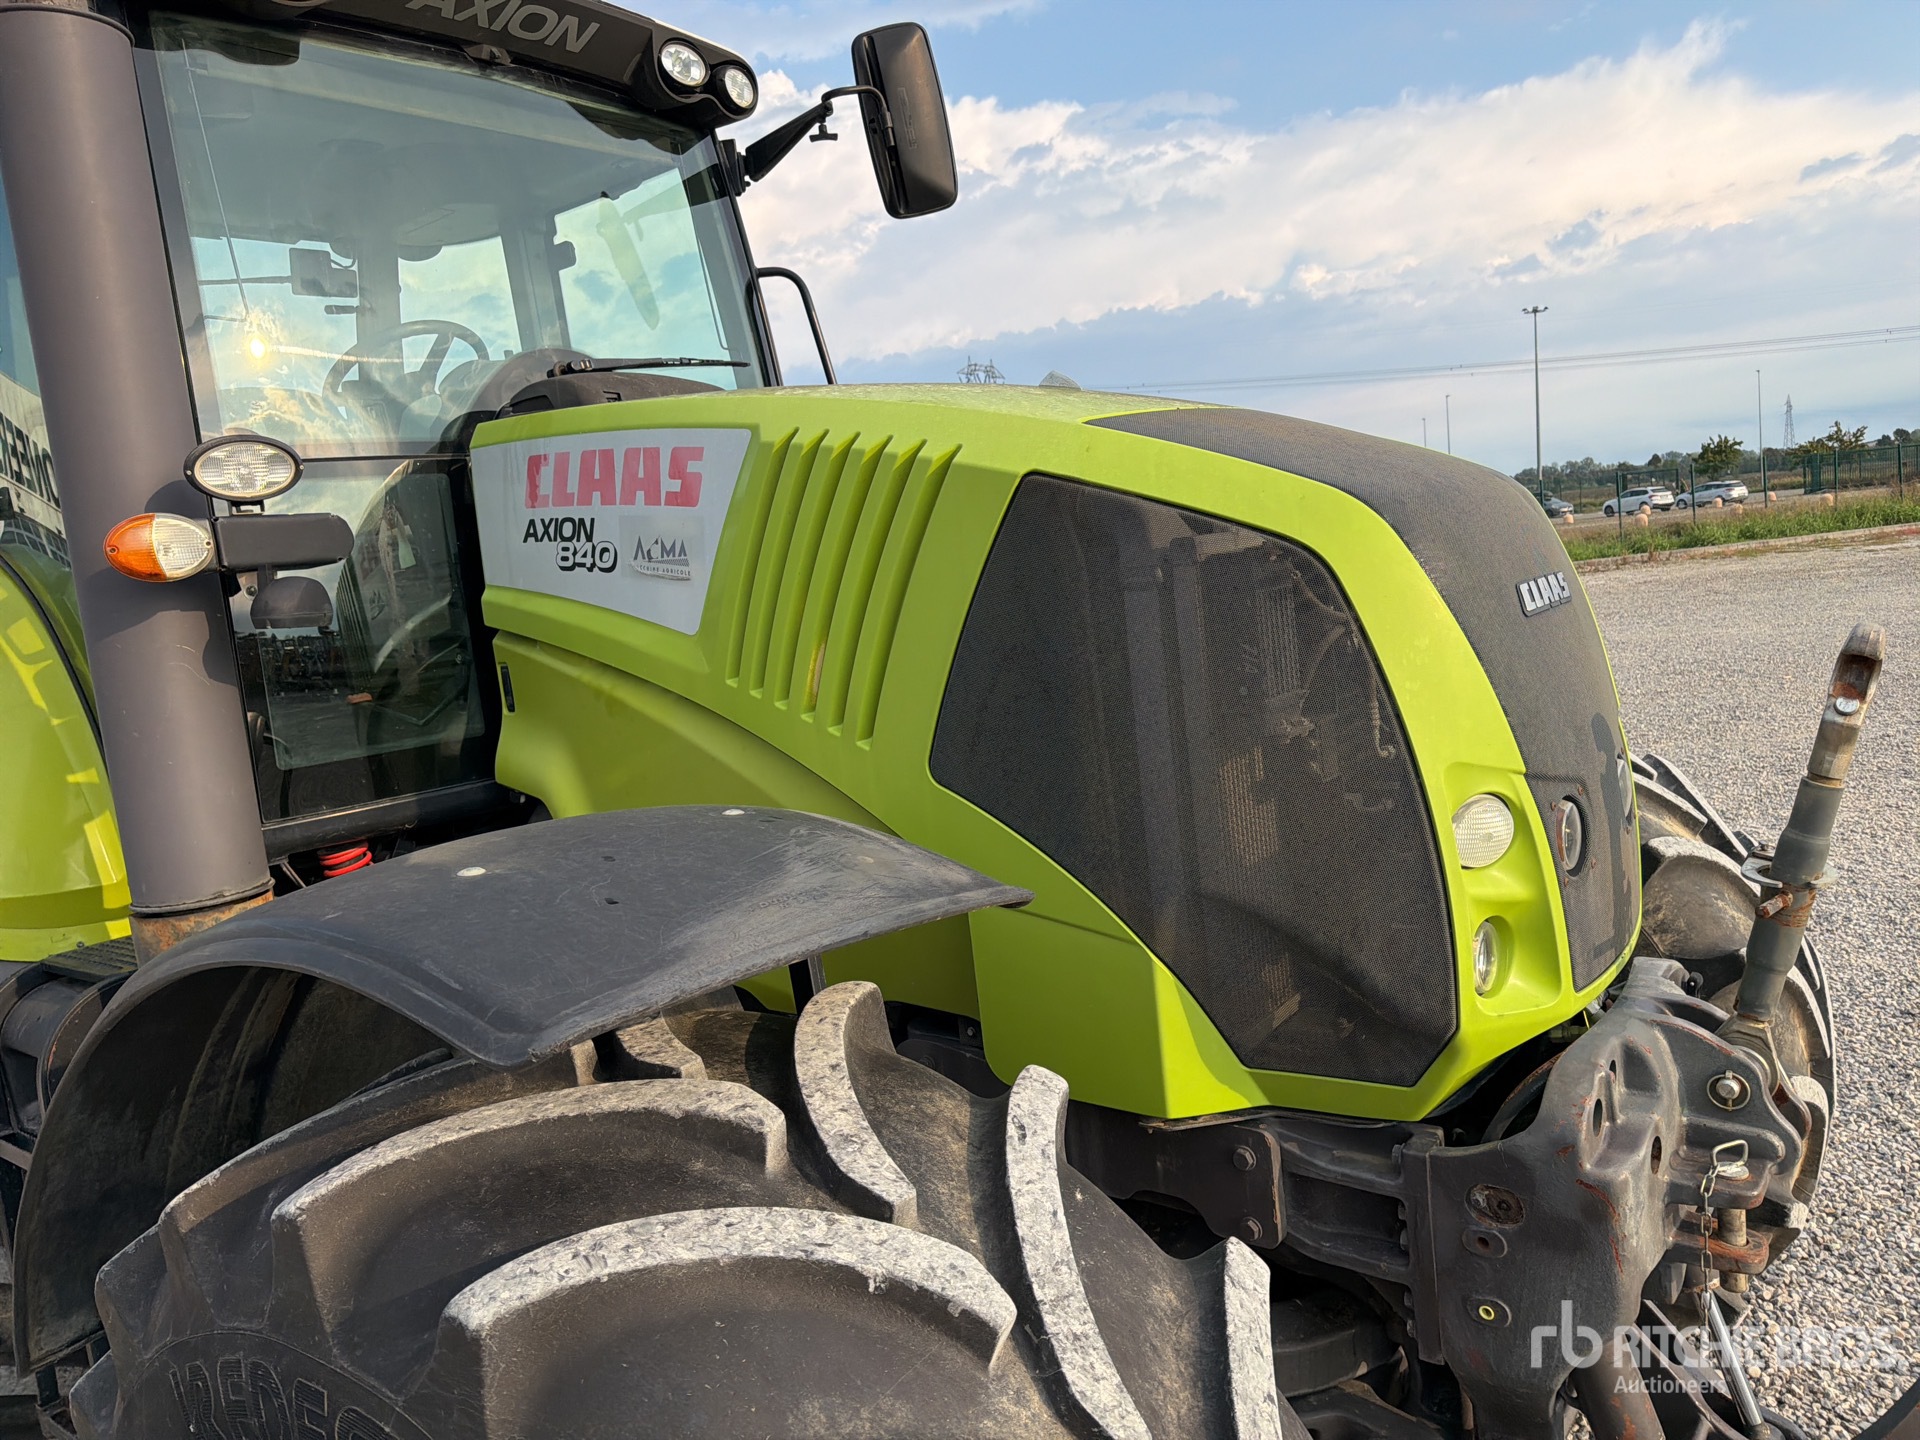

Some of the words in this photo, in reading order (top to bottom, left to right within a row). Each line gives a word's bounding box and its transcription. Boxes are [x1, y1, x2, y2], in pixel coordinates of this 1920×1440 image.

[526, 446, 704, 508] CLAAS
[523, 516, 595, 543] AXION
[556, 540, 617, 573] 840
[1518, 571, 1571, 612] CLAAS
